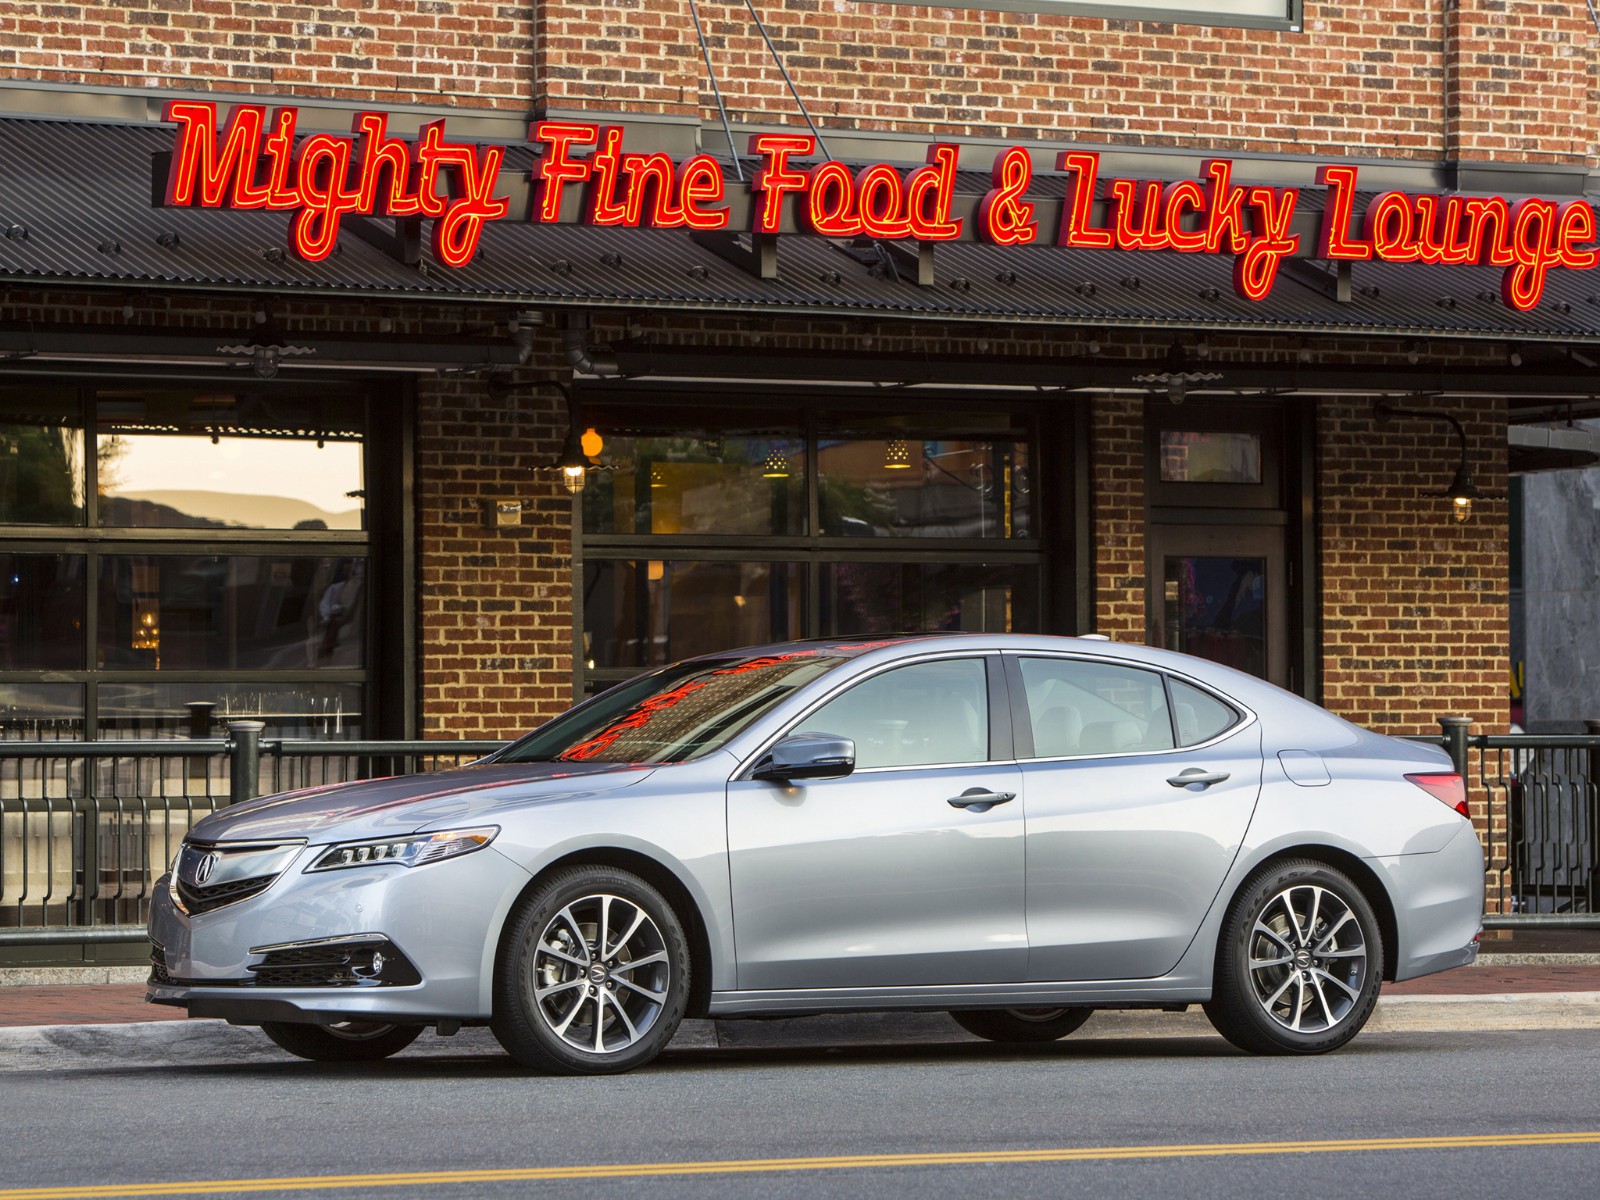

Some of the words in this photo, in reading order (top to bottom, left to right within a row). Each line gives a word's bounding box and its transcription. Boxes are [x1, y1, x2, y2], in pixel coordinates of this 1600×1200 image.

[160, 101, 510, 267] Mighty
[528, 120, 730, 230] Fine
[747, 133, 963, 240] Food
[978, 146, 1038, 246] &
[1055, 151, 1300, 300] Lucky
[1314, 166, 1600, 311] Lounge
[1239, 885, 1270, 946] EAGLE
